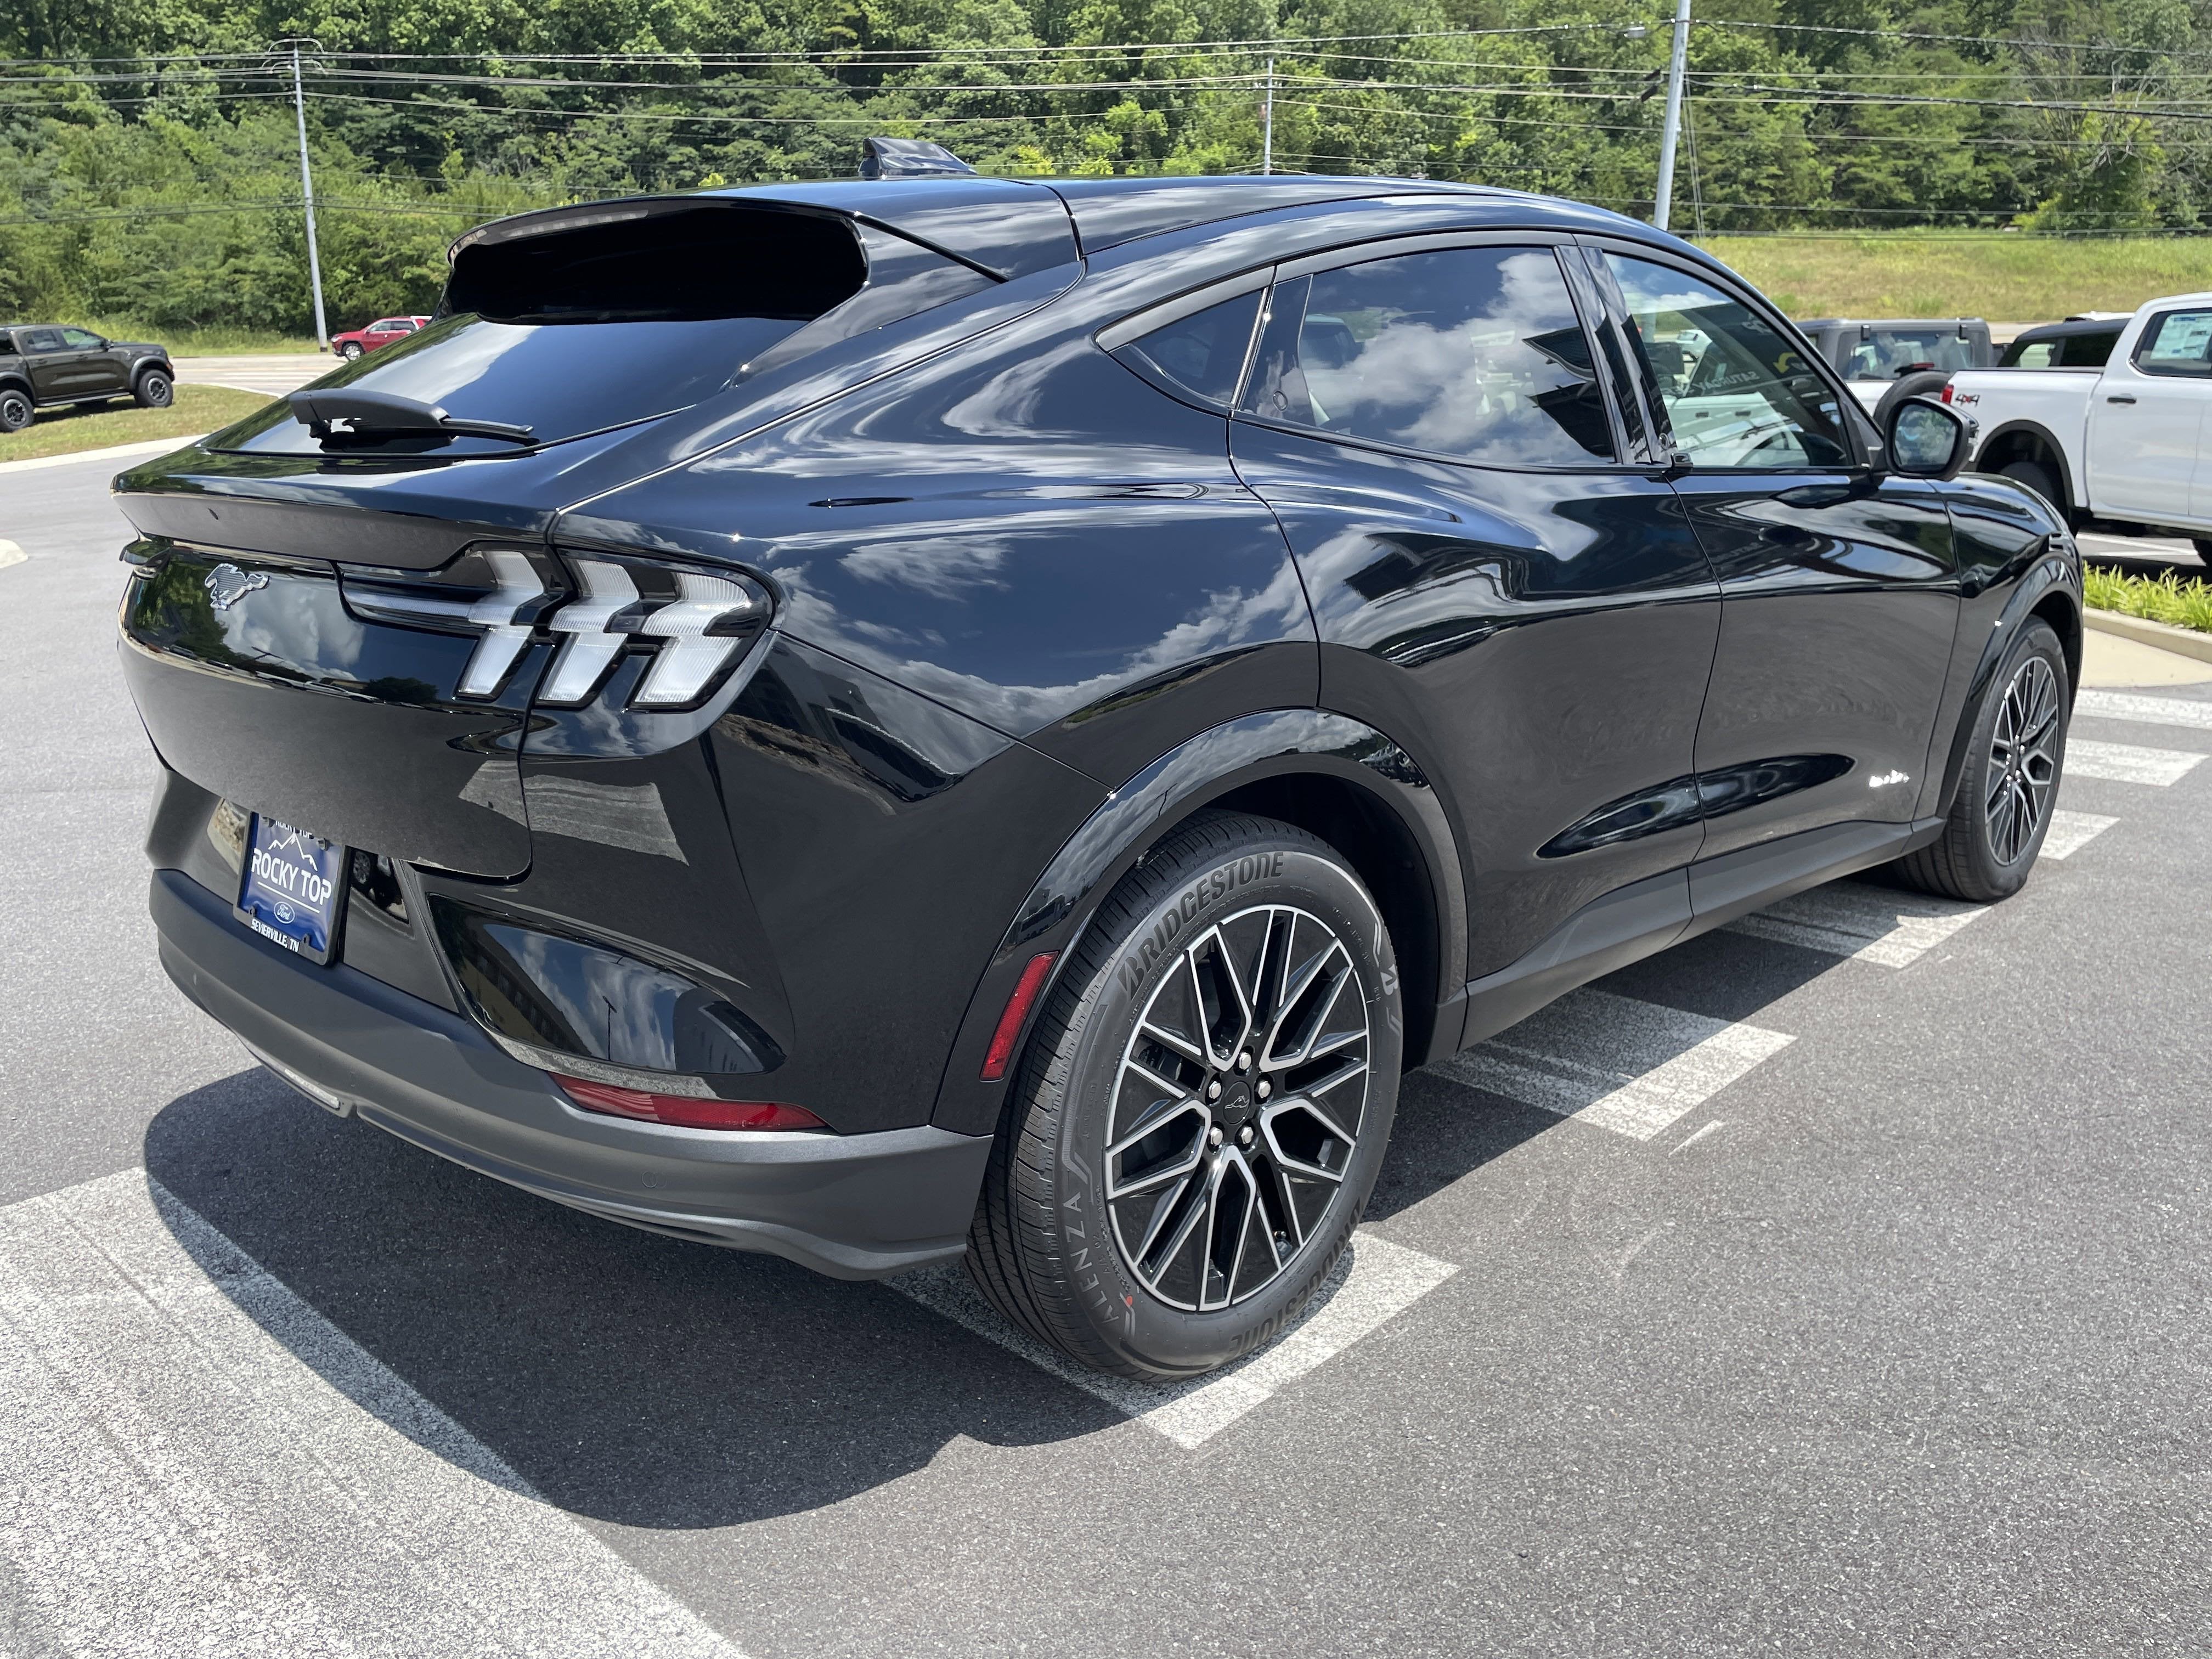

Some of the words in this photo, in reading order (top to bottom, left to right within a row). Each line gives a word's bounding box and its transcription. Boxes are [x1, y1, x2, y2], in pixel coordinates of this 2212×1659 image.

[251, 848, 299, 891] ROCKY
[301, 869, 332, 905] TOP
[276, 904, 291, 921] Ford
[1117, 851, 1284, 1002] BRIDGESTONE
[290, 938, 300, 953] TN
[1063, 1191, 1120, 1324] ALENZA
